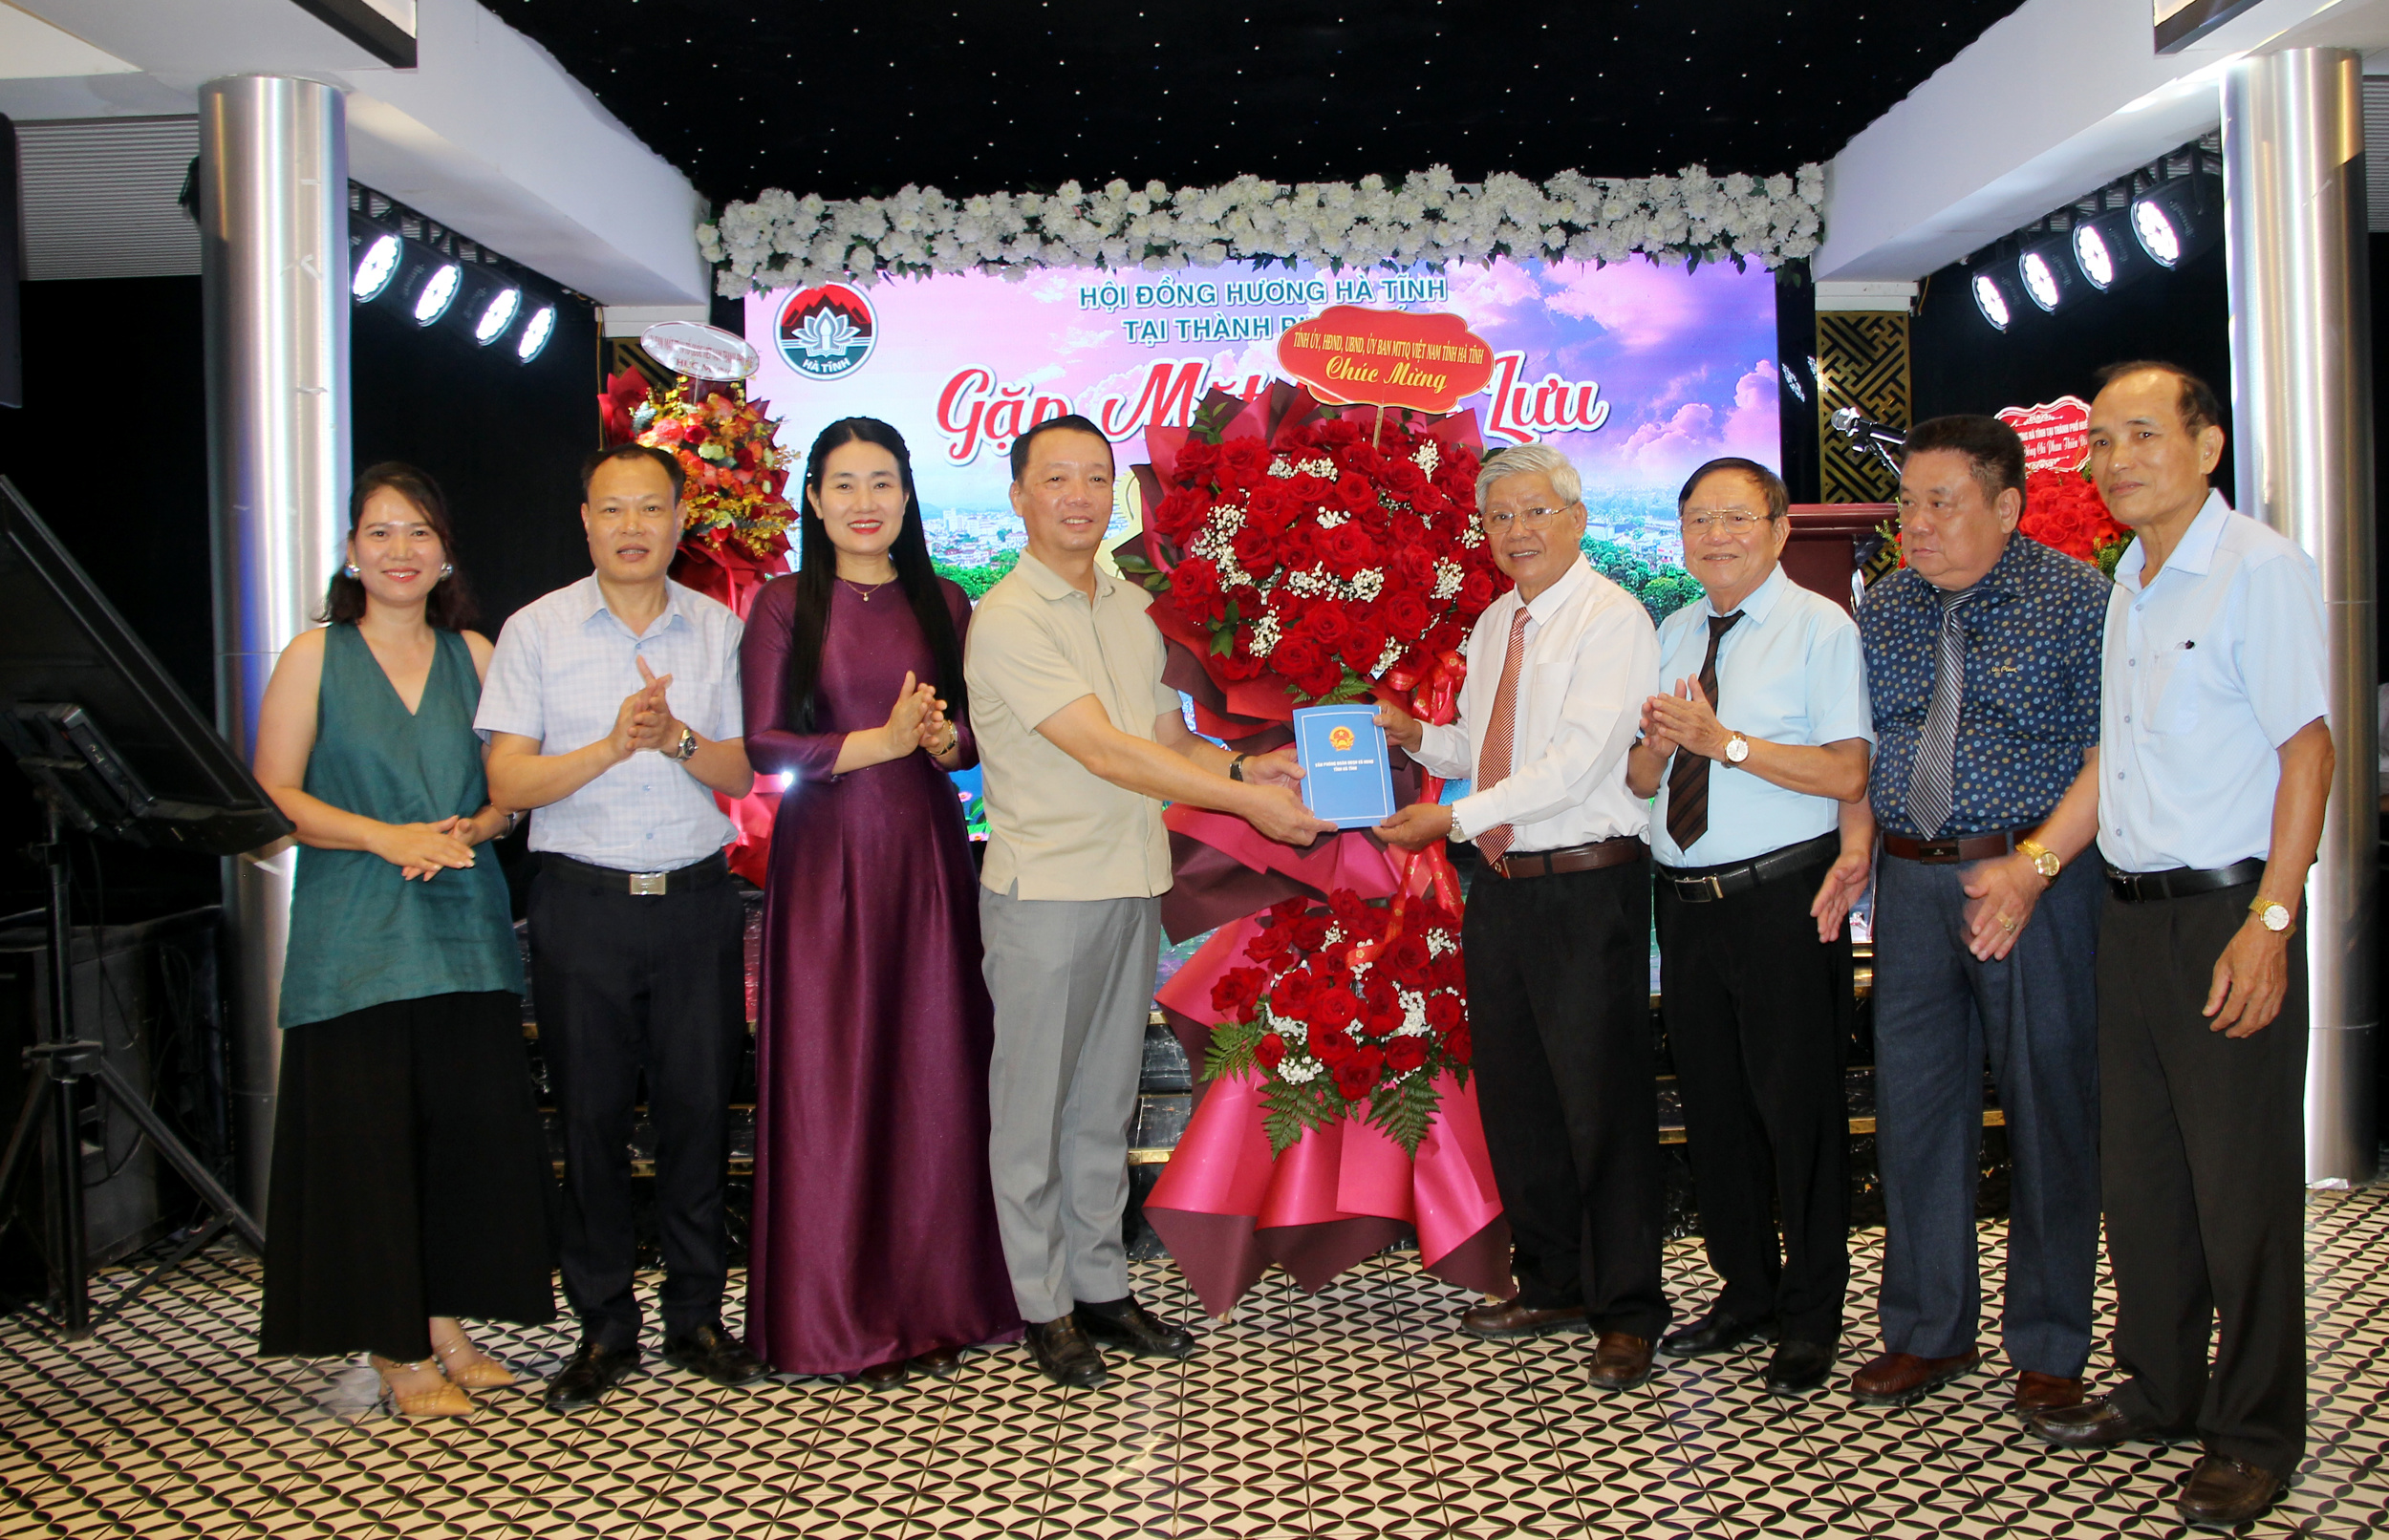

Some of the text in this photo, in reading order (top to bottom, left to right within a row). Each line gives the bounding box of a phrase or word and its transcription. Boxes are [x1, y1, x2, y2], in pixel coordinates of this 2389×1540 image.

[1080, 273, 1447, 311] HỘI ĐỒNG HƯƠNG HÀ TĨNH
[1122, 319, 1166, 346] TẠI
[1174, 312, 1272, 340] THÀNH
[1293, 327, 1310, 348] TỈNH
[1322, 334, 1344, 353] HĐND,
[1345, 335, 1366, 355] UBND,
[1377, 339, 1392, 356] BAN
[1391, 340, 1411, 360] MTTQ
[1411, 338, 1427, 363] VIỆT
[1426, 344, 1442, 361] NAM
[1457, 344, 1468, 363] HÀ
[802, 357, 851, 374] HÀ TĨNH
[1325, 355, 1448, 395] Chúc Mừng
[1487, 354, 1605, 443] Lưu
